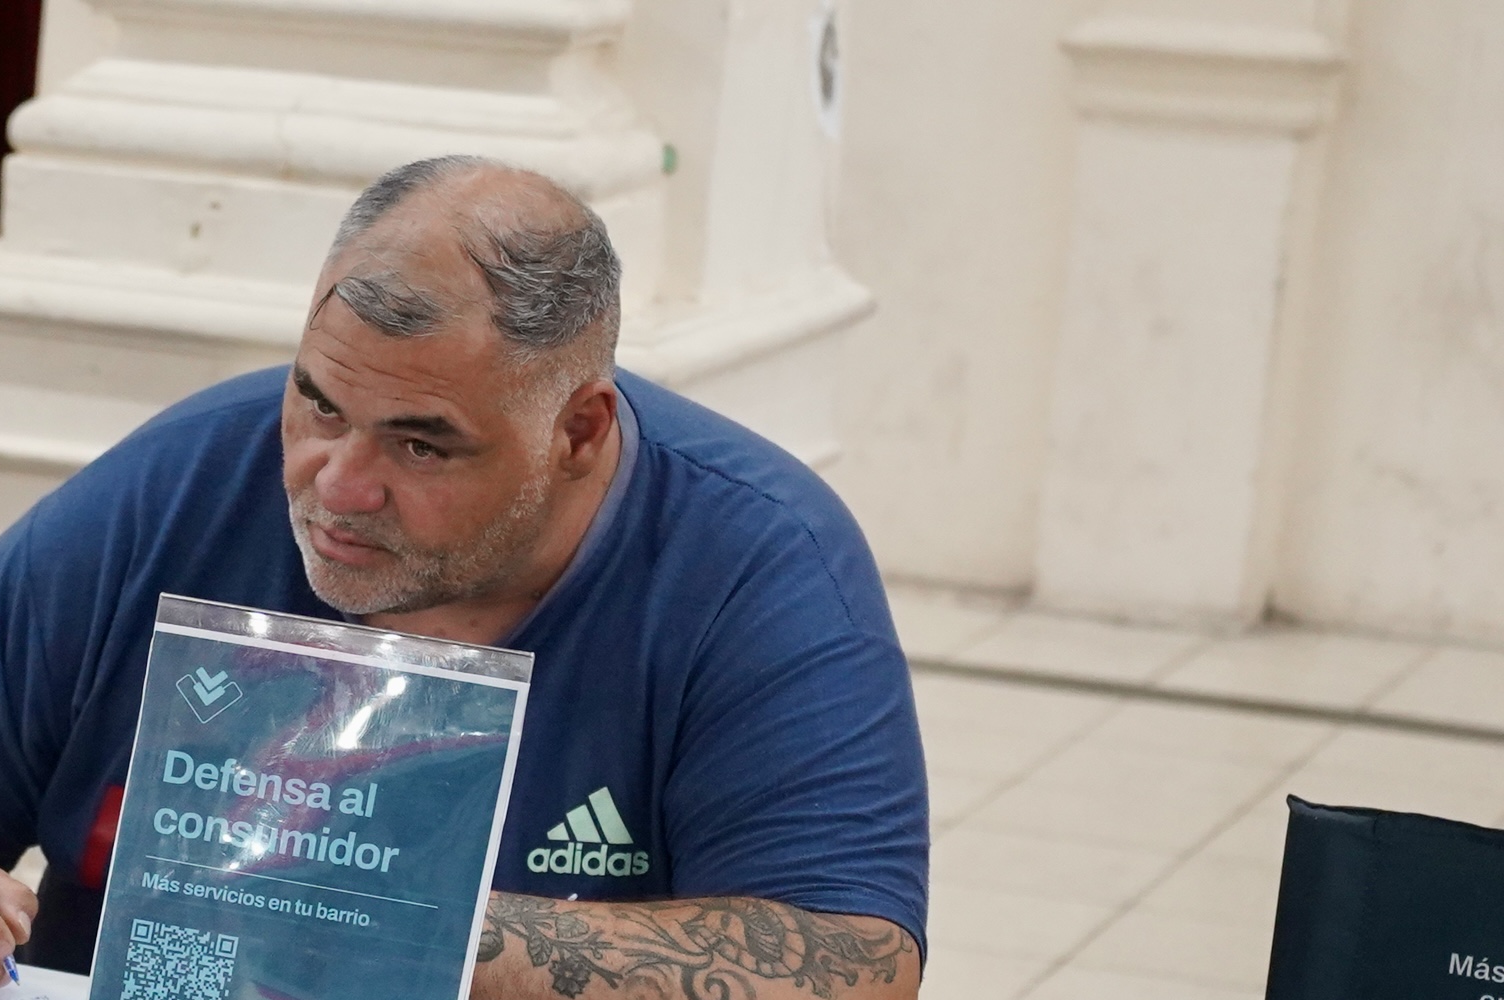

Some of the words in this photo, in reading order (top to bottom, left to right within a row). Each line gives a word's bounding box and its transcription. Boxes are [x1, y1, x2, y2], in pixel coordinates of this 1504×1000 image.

[162, 749, 331, 812] Defensa
[339, 782, 378, 819] al
[153, 805, 399, 873] consumidor
[527, 842, 650, 877] adidas
[141, 871, 180, 893] Más
[183, 882, 265, 908] servicios
[268, 896, 291, 913] en
[295, 899, 313, 917] tu
[316, 902, 371, 927] barrio
[1449, 952, 1504, 984] Más
